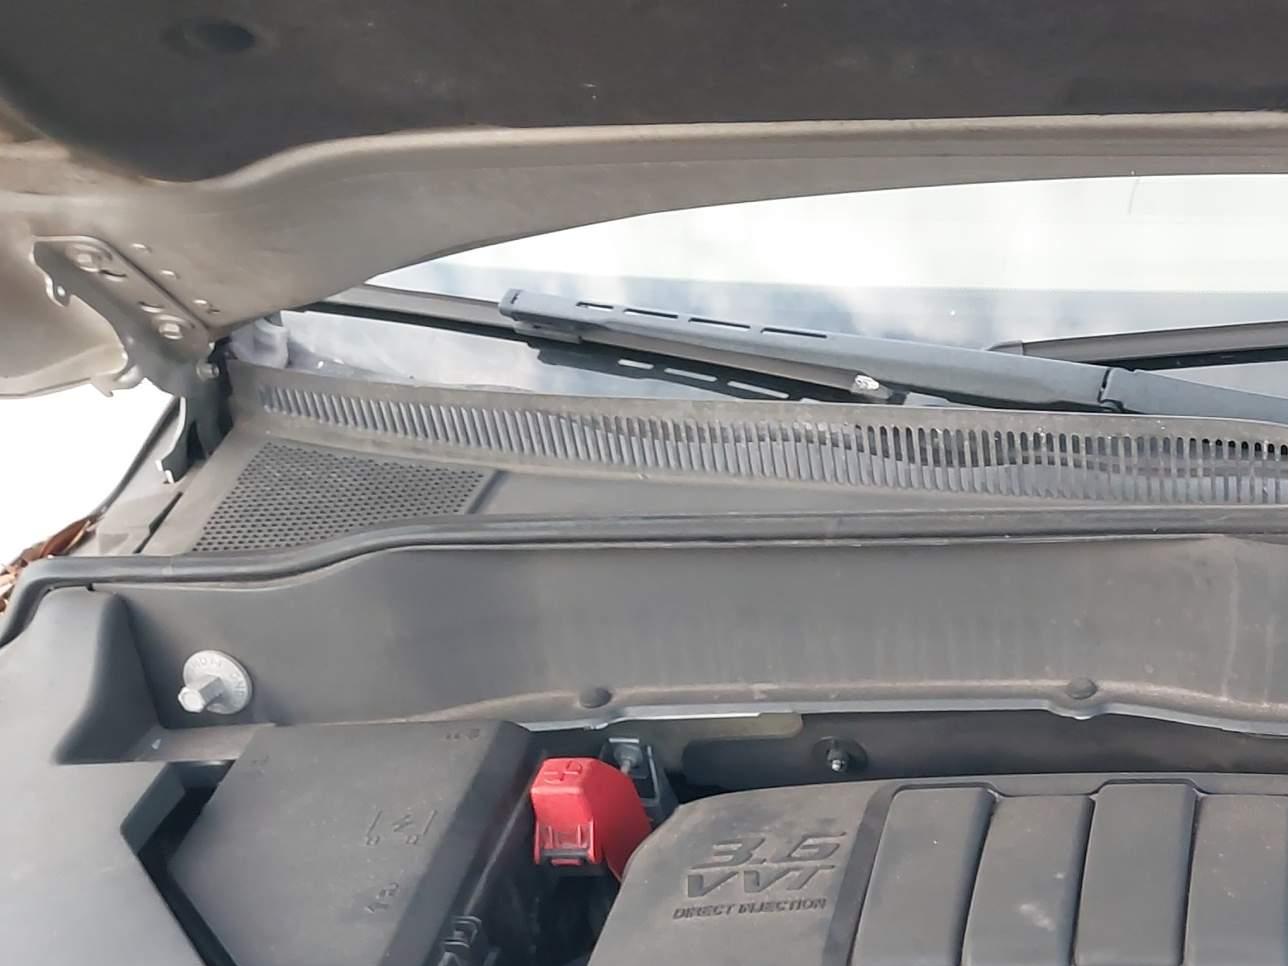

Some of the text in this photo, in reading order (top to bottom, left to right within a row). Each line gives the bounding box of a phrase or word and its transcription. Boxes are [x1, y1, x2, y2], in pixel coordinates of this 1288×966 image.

[689, 831, 848, 870] 3.6
[687, 864, 836, 898] VVT
[672, 898, 827, 920] DIRECT INJECTION
